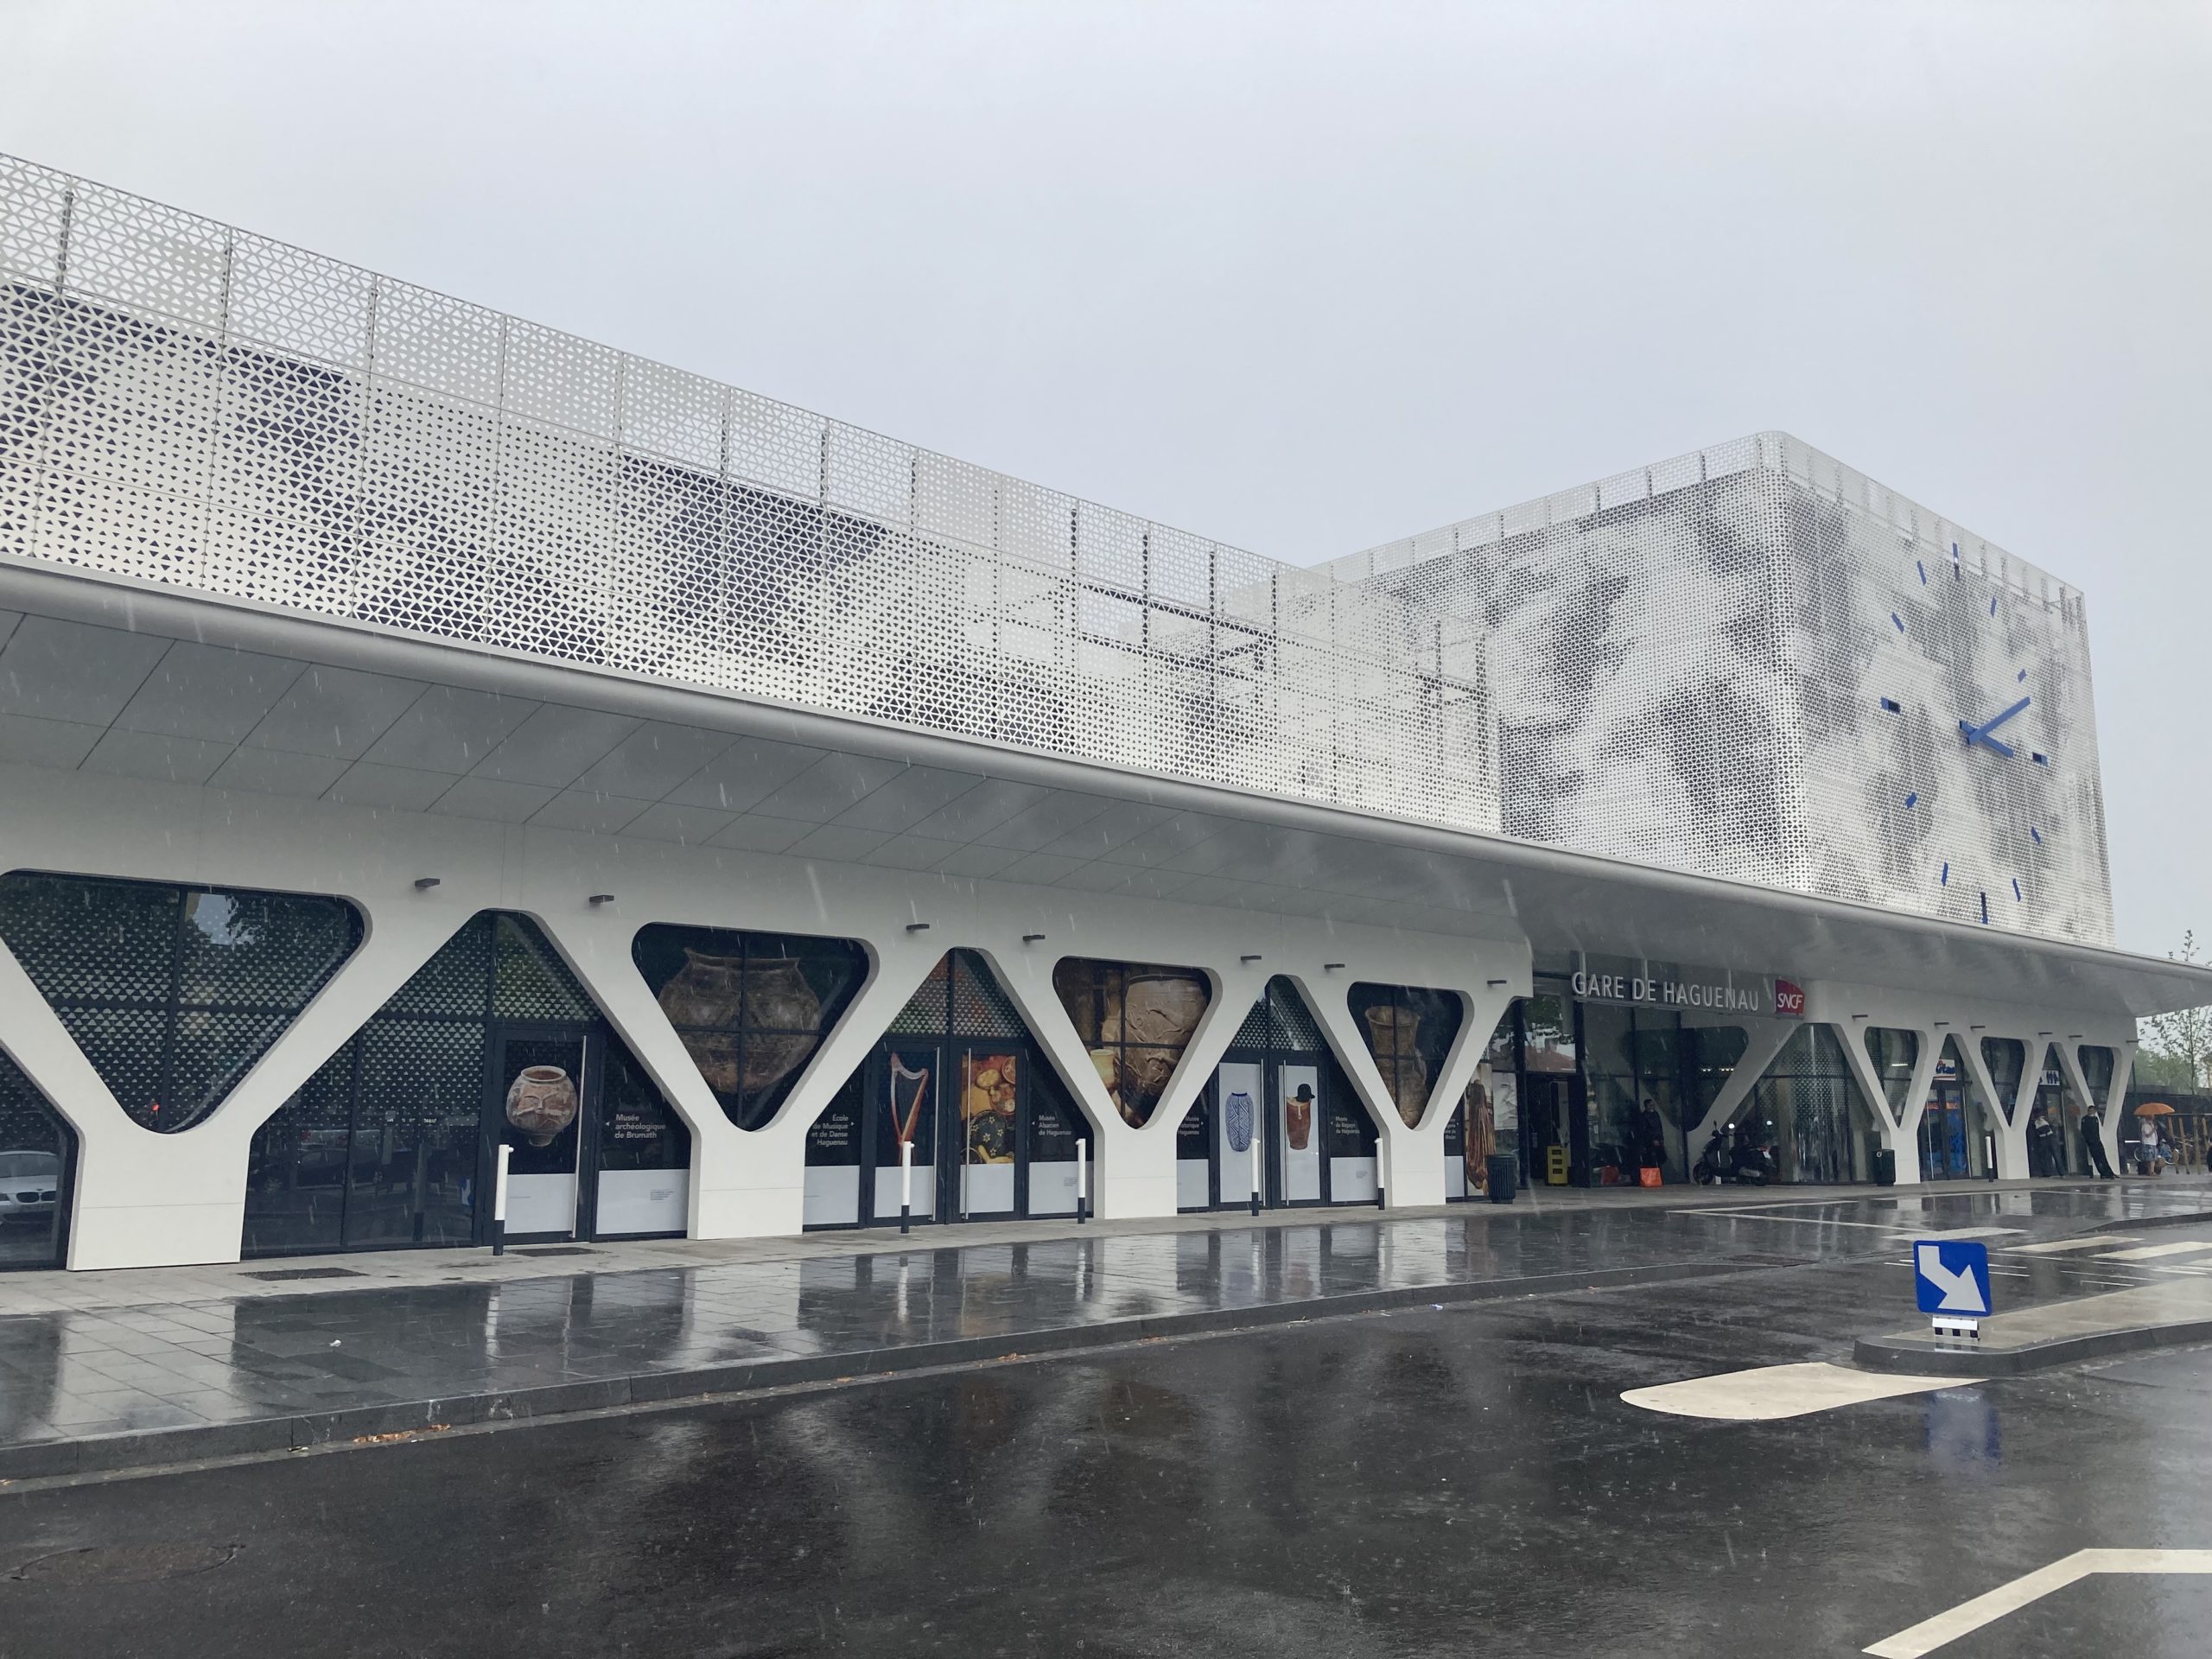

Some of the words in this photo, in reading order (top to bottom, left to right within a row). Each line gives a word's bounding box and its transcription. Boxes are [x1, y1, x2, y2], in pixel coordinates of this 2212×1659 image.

[1572, 971, 1624, 1000] GARE
[1632, 977, 1656, 1001] DE
[1662, 981, 1758, 1011] HAGUENAU
[1777, 993, 1803, 1009] SNCF
[832, 1113, 849, 1122] École
[615, 1122, 666, 1132] archéologique
[817, 1139, 849, 1147] Haguenau
